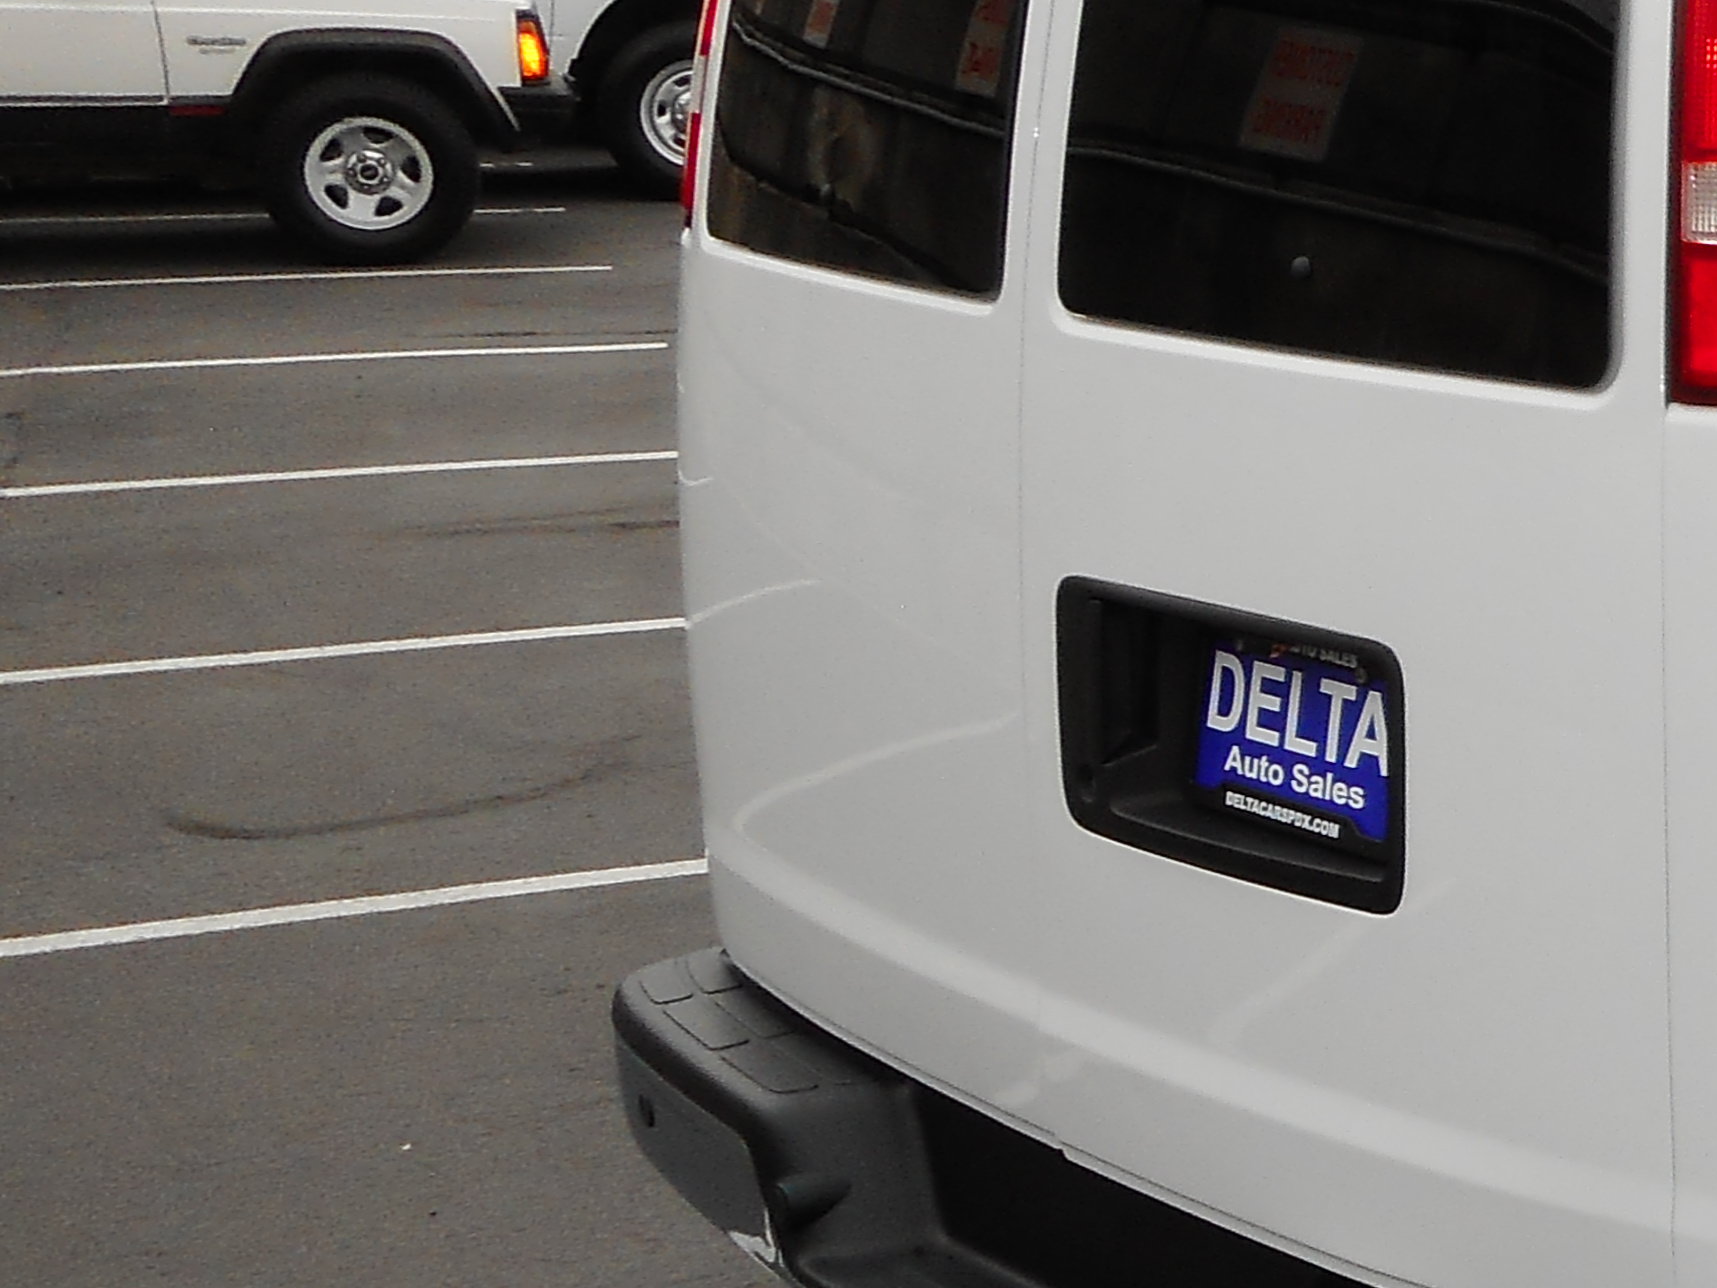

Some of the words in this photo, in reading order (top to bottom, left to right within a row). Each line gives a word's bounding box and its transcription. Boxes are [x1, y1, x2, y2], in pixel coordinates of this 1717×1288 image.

[1206, 649, 1389, 777] DELTA
[1223, 745, 1285, 786] Auto
[1290, 763, 1366, 809] Sales
[1225, 790, 1342, 838] DELTACARSPDX.COM
